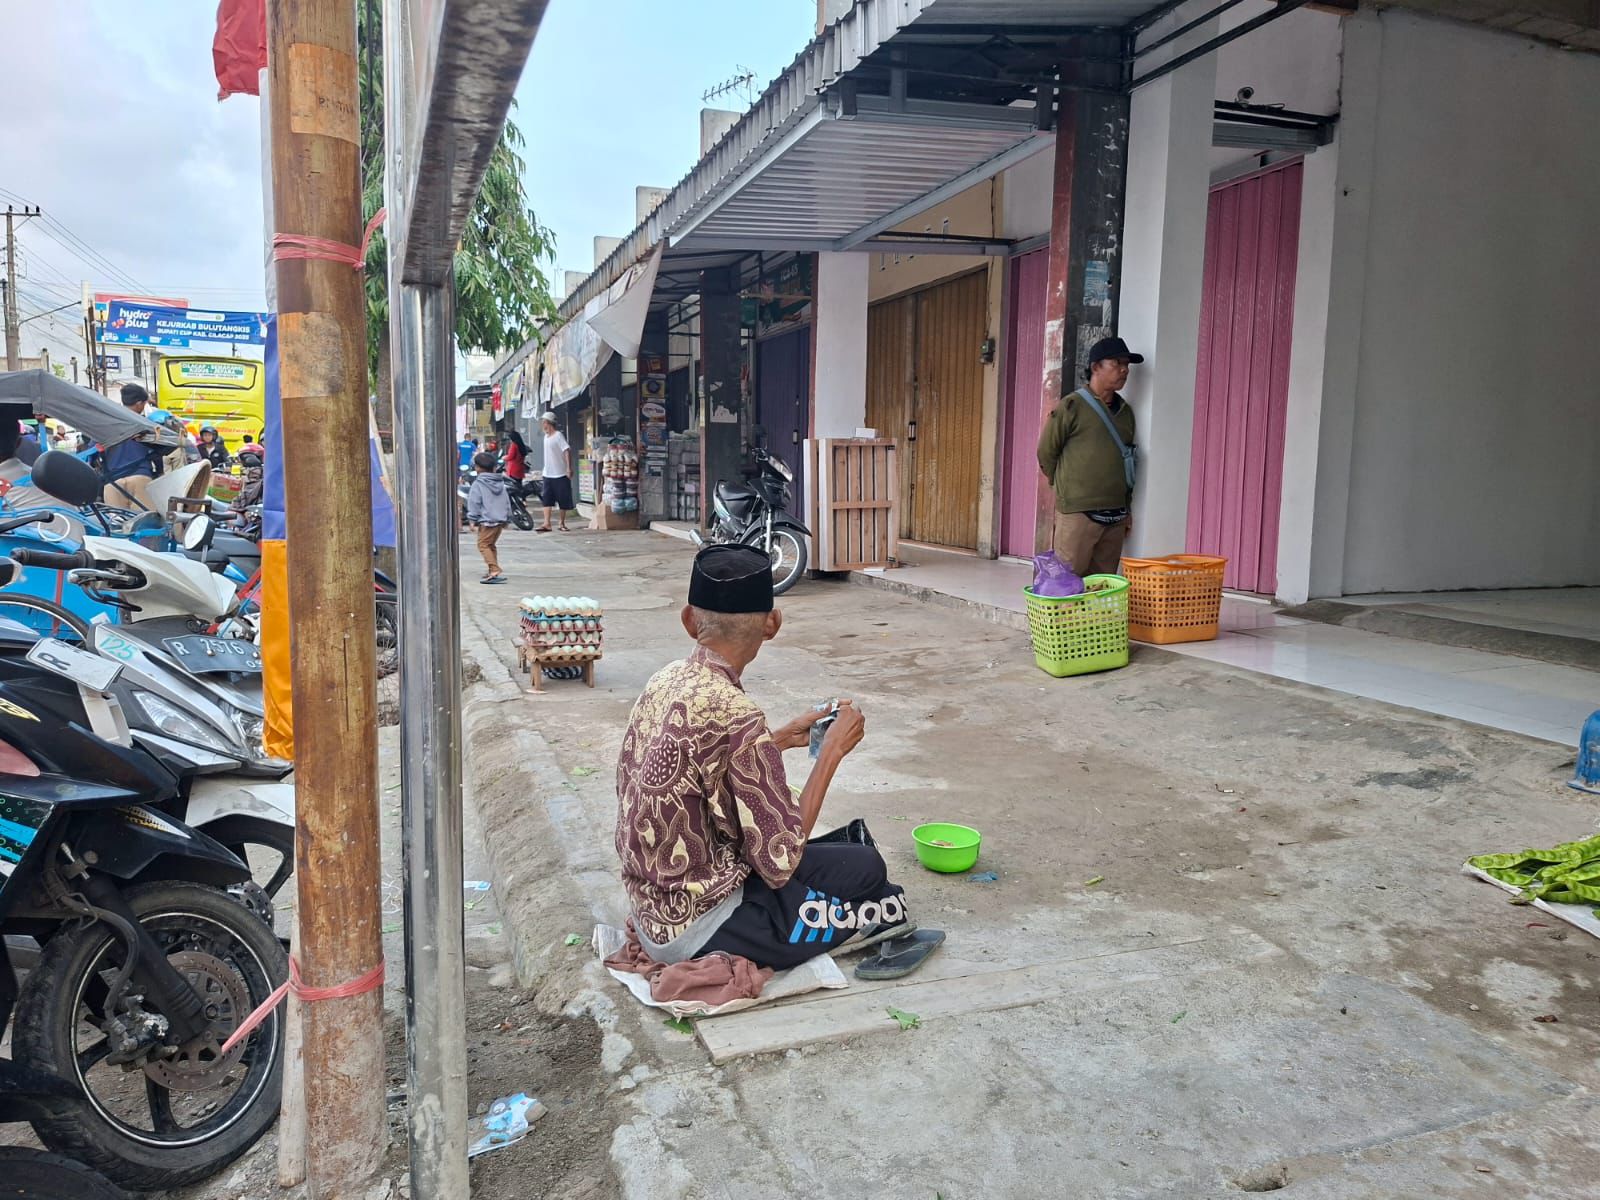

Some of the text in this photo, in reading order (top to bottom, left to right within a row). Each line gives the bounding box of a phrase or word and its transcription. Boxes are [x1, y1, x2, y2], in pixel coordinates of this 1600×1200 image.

[120, 308, 152, 320] hydro
[125, 319, 149, 328] plus
[157, 320, 250, 333] KEJURKAB BULUTANGKIS
[99, 635, 139, 660] 125
[172, 641, 190, 655] R
[37, 652, 71, 671] R
